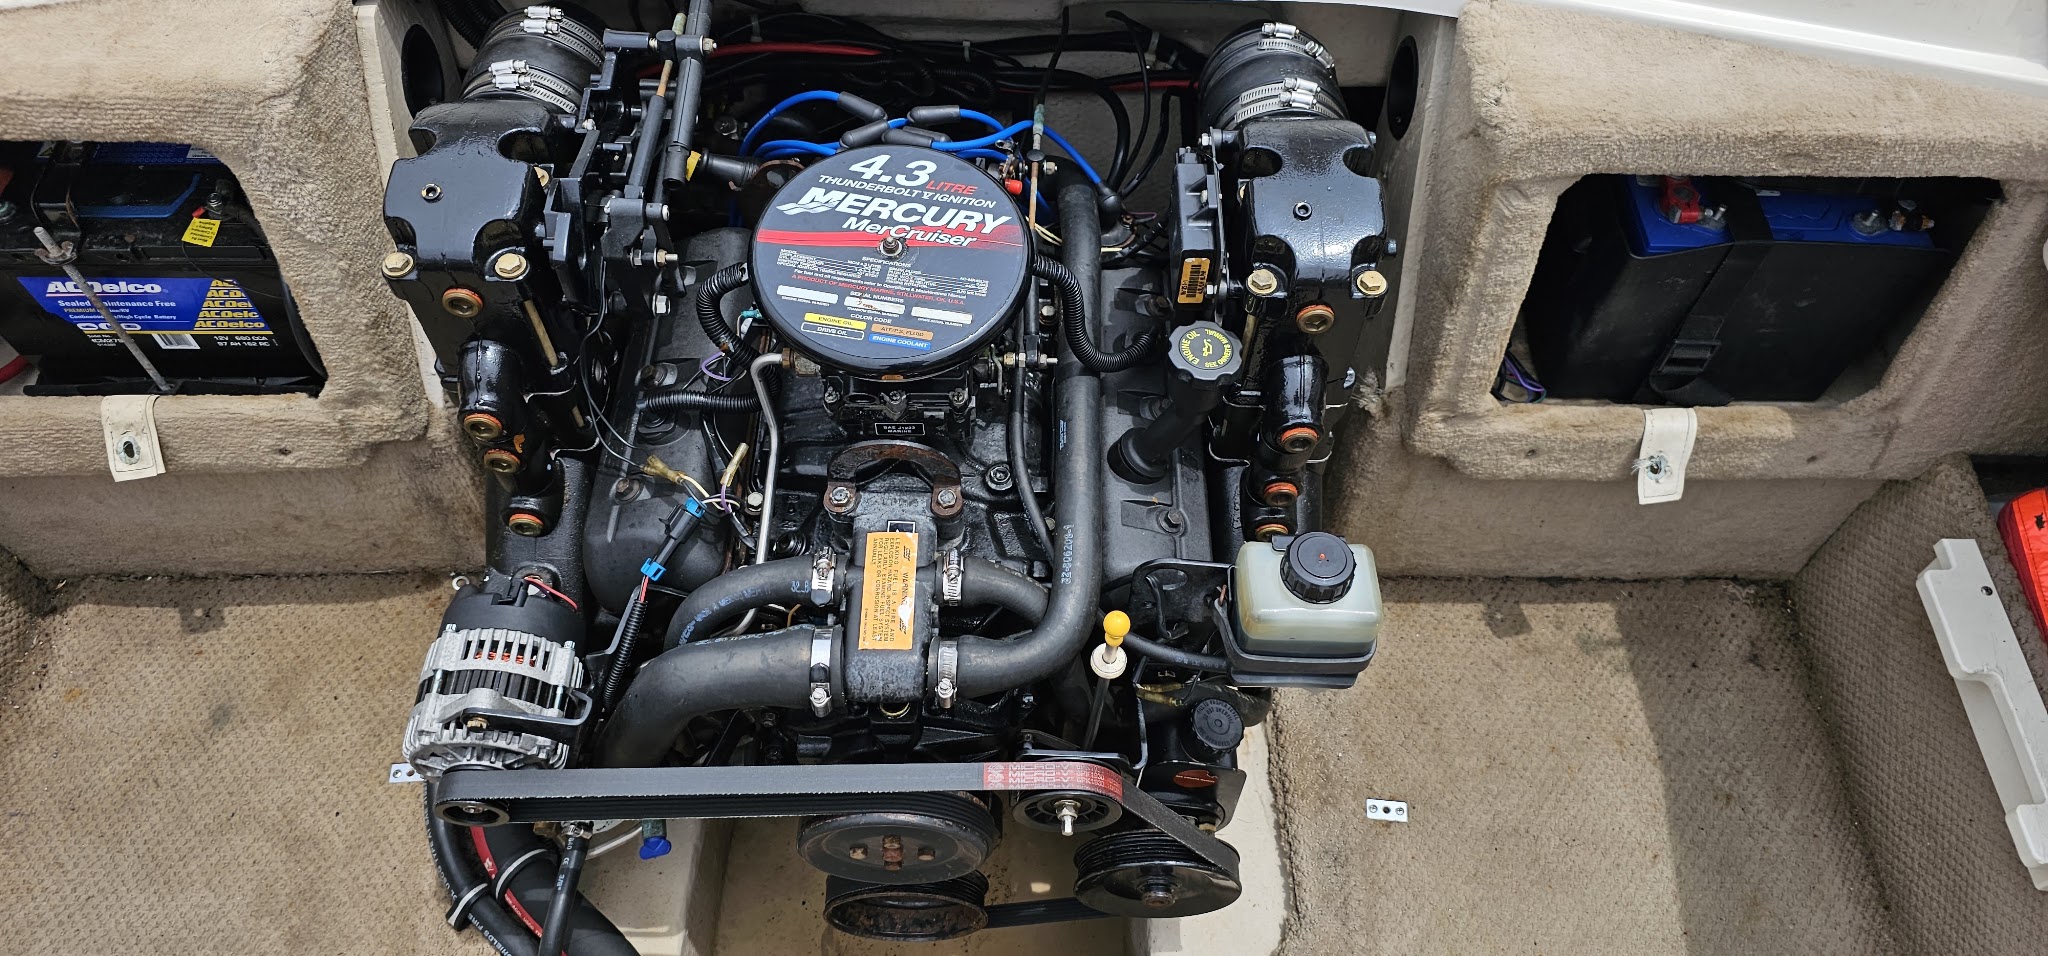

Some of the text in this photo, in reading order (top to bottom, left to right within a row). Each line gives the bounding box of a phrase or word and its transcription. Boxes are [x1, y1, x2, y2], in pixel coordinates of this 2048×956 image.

[849, 154, 978, 195] 4.3 LITRE
[818, 175, 923, 198] THUNDERBOLT
[933, 193, 997, 209] IGNITION
[797, 186, 1013, 235] MERCURY
[842, 217, 978, 247] MerCruiser
[47, 281, 162, 293] ACDelco
[797, 275, 827, 284] PRODUCT
[194, 320, 265, 328] ACDelco
[850, 313, 893, 324] COLOR CODE
[817, 326, 836, 335] DRIVE
[872, 335, 929, 348] ENGINE COOLANT
[1182, 330, 1200, 365] ENGINE OIL
[467, 912, 484, 931] FIRE
